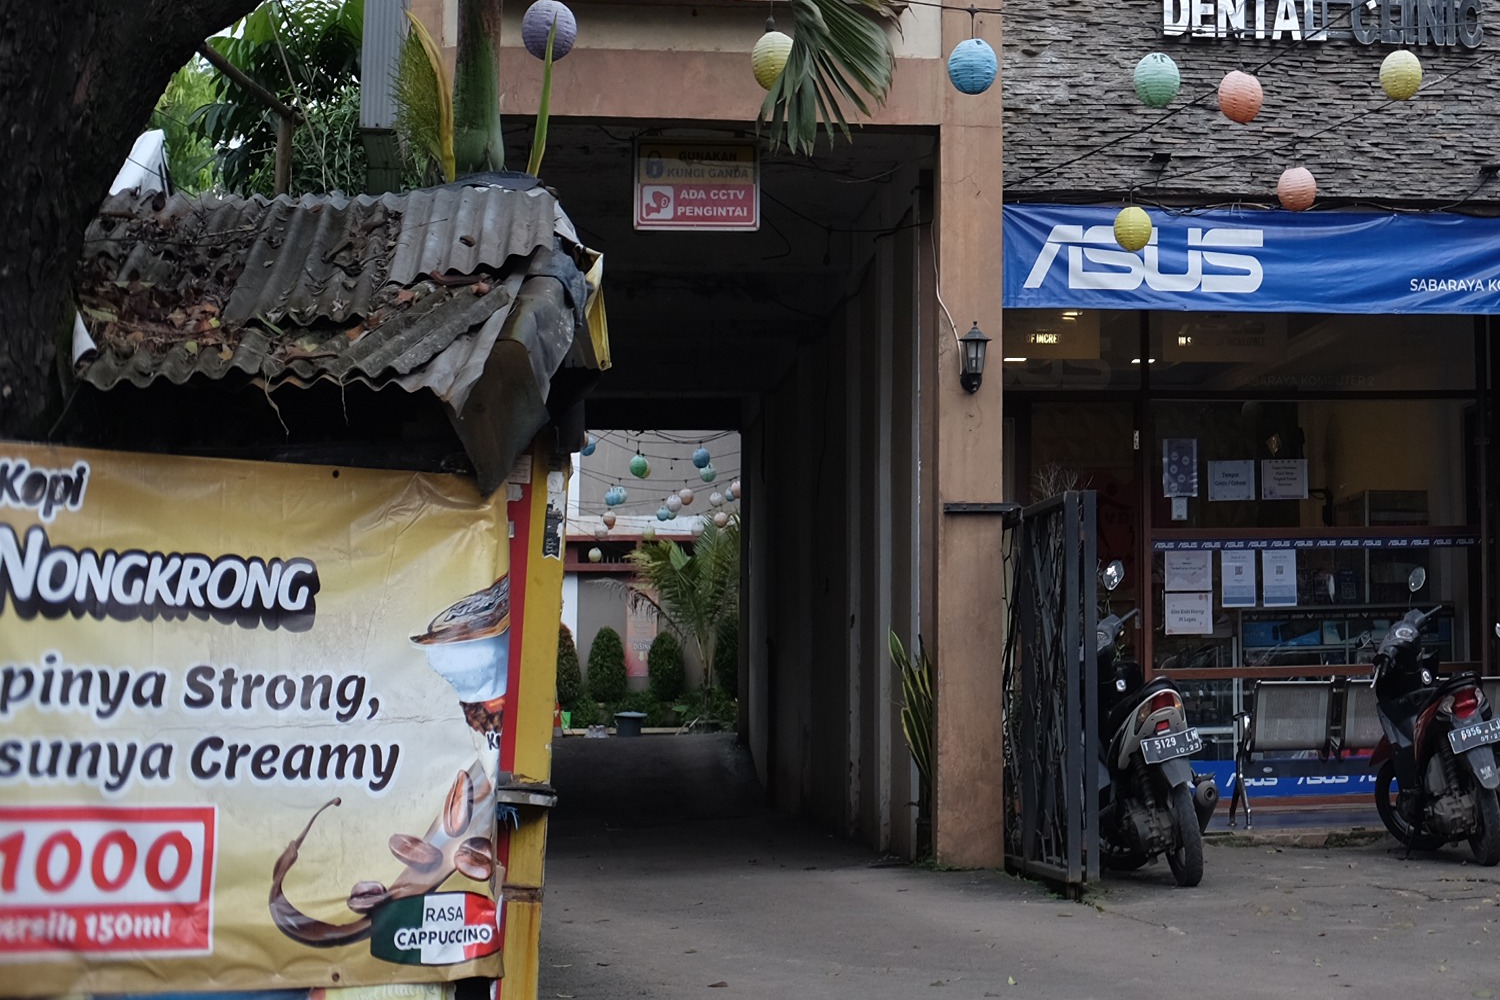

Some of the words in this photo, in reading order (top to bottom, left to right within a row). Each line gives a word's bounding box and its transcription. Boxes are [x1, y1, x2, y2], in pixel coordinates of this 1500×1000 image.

[679, 151, 737, 161] GUNAKAN
[708, 168, 749, 178] GANDA
[680, 190, 706, 199] ADA
[710, 190, 745, 199] CCTV
[677, 207, 747, 216] PENGINTAI
[1023, 225, 1264, 294] ASUS
[1409, 278, 1486, 293] SABARAYA
[0, 463, 88, 520] Kopi
[0, 525, 316, 615] NONGKRONG
[0, 654, 166, 720] pinya
[184, 664, 381, 722] Strong,
[1450, 733, 1455, 742] T
[1489, 720, 1500, 731] LJ
[1143, 742, 1148, 751] T
[1154, 737, 1177, 750] 5129
[0, 740, 172, 792] sunya
[190, 736, 400, 792] Creamy
[0, 829, 193, 893] 1000
[425, 905, 464, 923] RASA
[85, 910, 171, 943] 150ml
[395, 927, 492, 949] CAPPUCCINO
